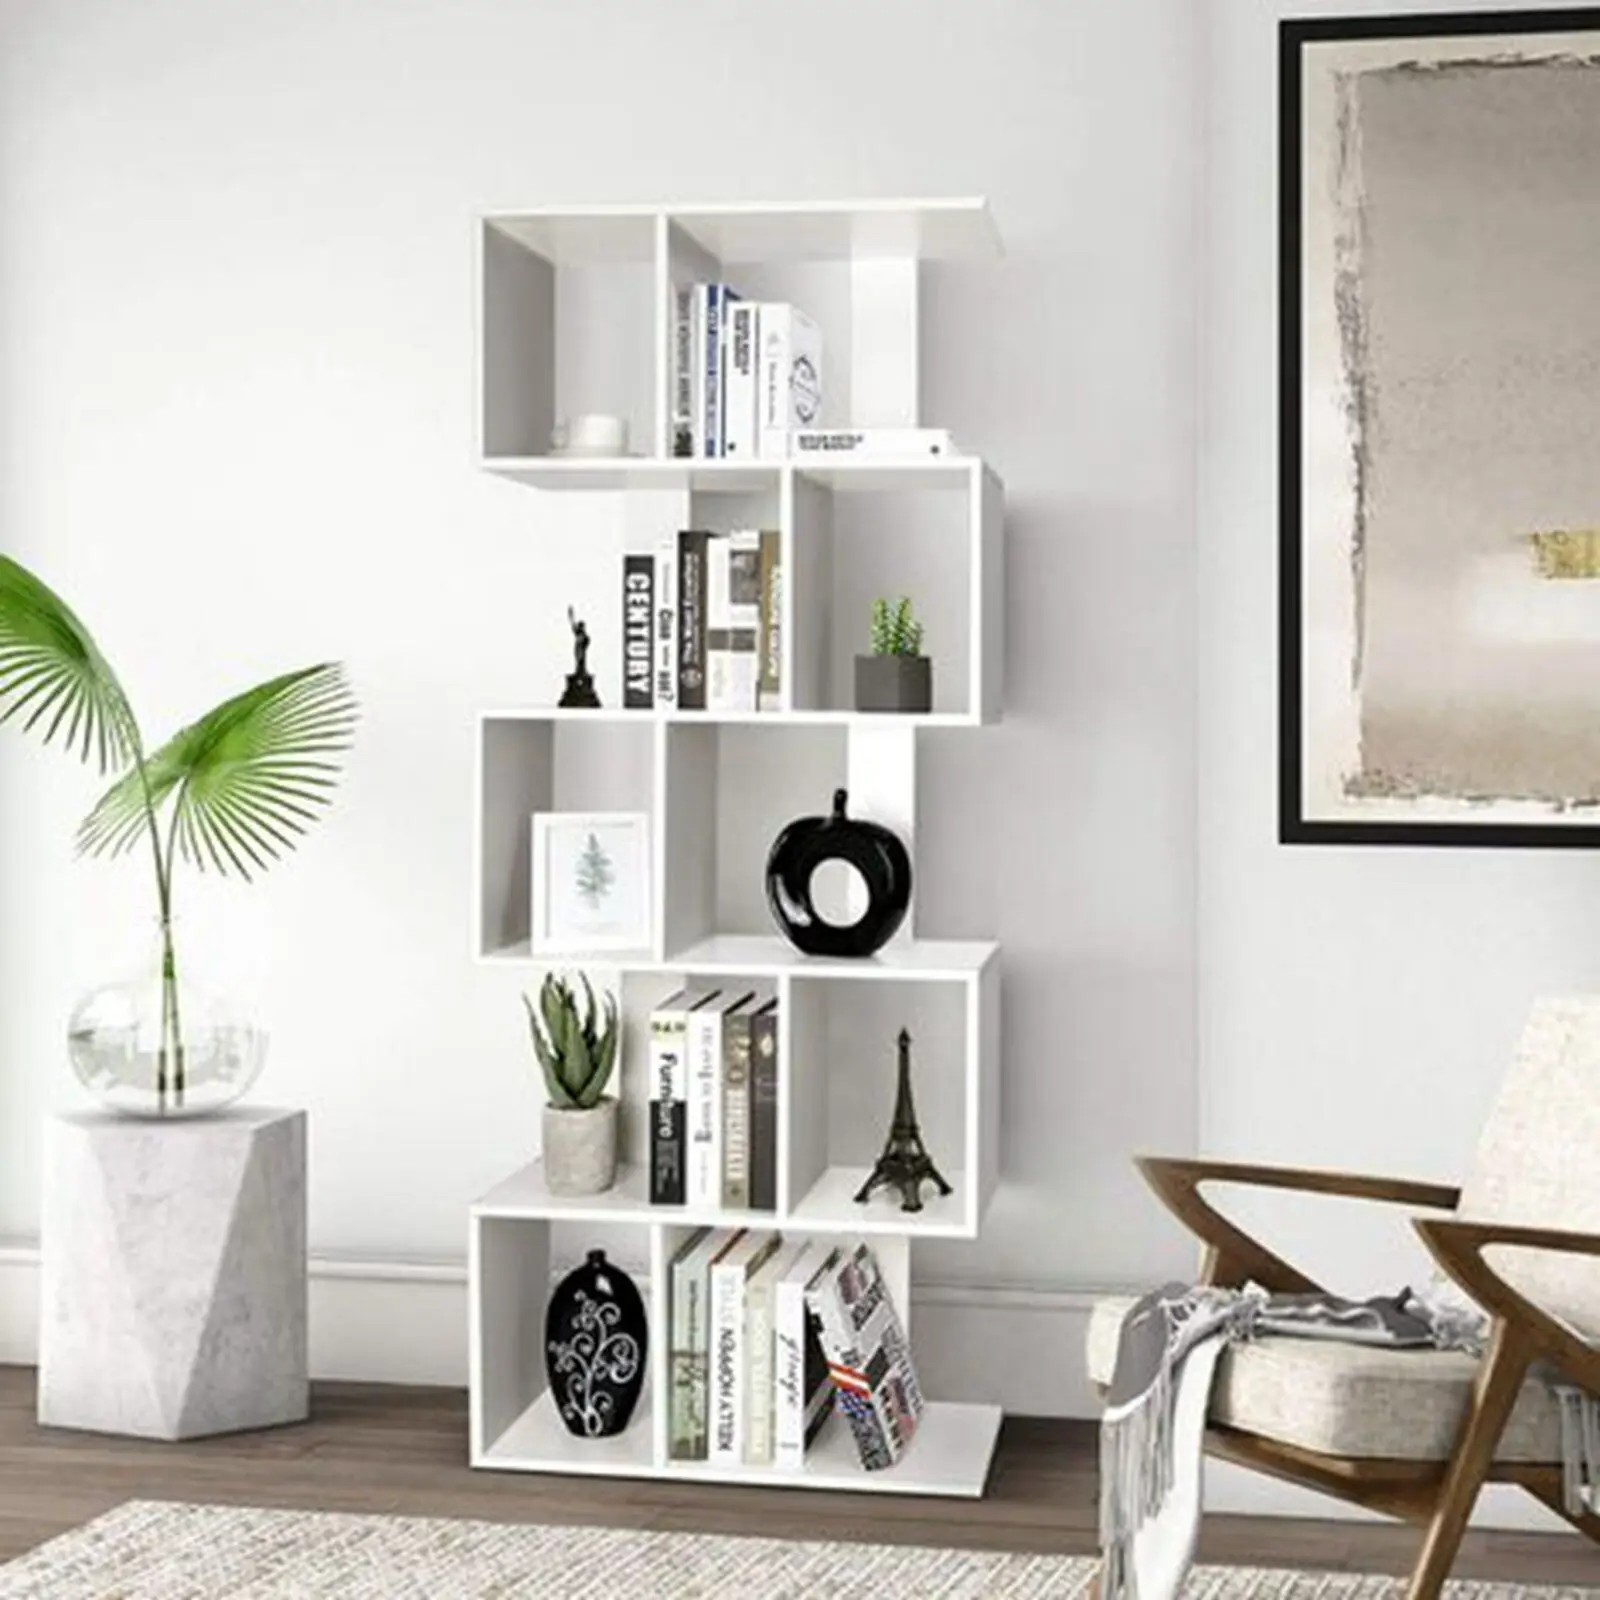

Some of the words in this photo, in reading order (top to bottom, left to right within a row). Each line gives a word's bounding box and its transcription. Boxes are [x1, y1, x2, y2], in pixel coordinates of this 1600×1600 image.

[626, 572, 651, 693] CENTURY
[658, 1053, 679, 1138] Furniture
[718, 1327, 737, 1397] HOPPEN
[717, 1400, 735, 1452] KELLY
